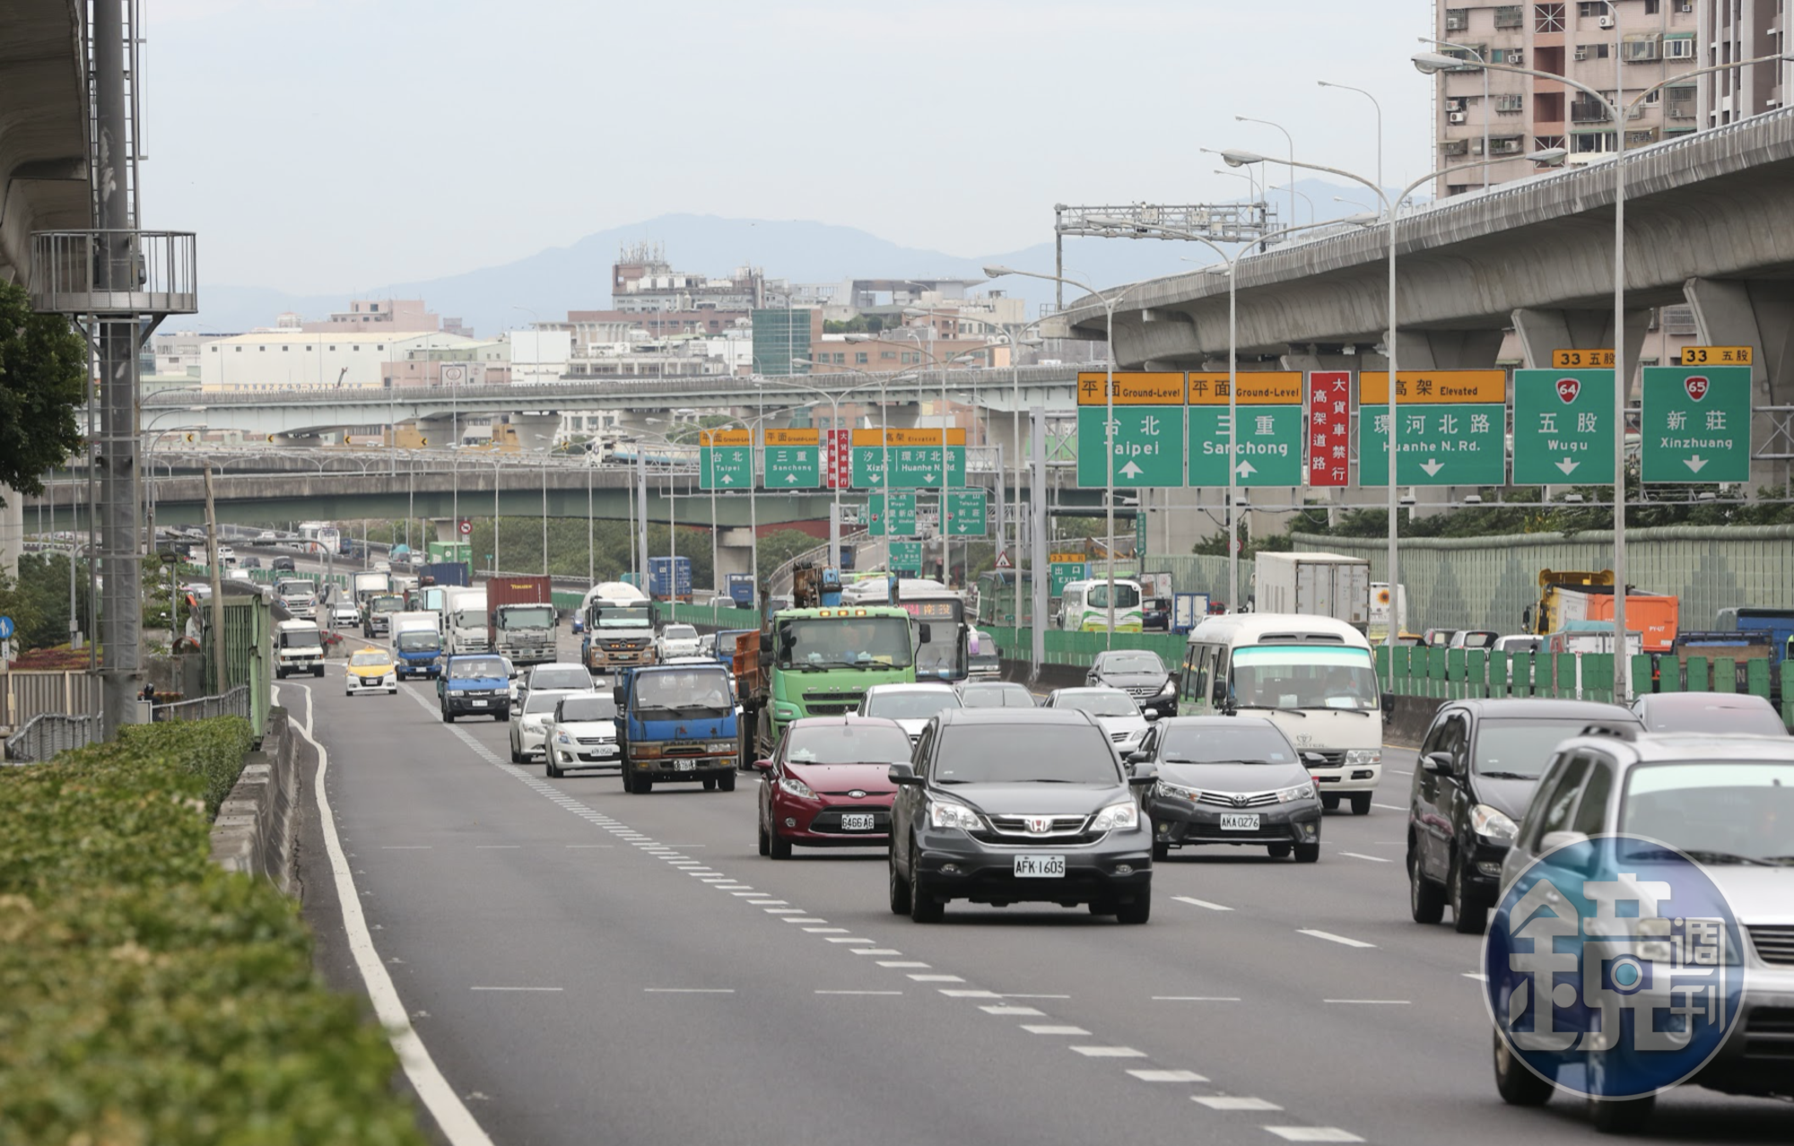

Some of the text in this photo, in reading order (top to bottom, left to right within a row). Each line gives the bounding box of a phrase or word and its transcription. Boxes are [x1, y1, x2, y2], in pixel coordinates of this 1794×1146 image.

[1560, 353, 1616, 365] 33 五股
[1686, 350, 1749, 362] 33 五股
[1122, 387, 1181, 397] Ground-Level
[1192, 380, 1300, 398] 平面 Ground-Level
[1440, 385, 1478, 397] Elevated
[1559, 384, 1577, 396] 64
[1688, 381, 1706, 393] 65
[1102, 415, 1161, 437] 台北
[1214, 415, 1276, 437] 三重
[1374, 413, 1491, 436] 環河北路
[1537, 412, 1597, 434] 五股
[1666, 410, 1727, 431] 新莊
[1312, 389, 1327, 470] 高架道路
[1331, 378, 1347, 481] 大貨車禁行
[1441, 440, 1456, 452] N.
[1458, 440, 1481, 452] Rd.
[1547, 439, 1588, 453] Wugu
[1660, 436, 1734, 450] Xinzhuang
[772, 464, 812, 472] Sanchong
[901, 463, 932, 472] Huanhe
